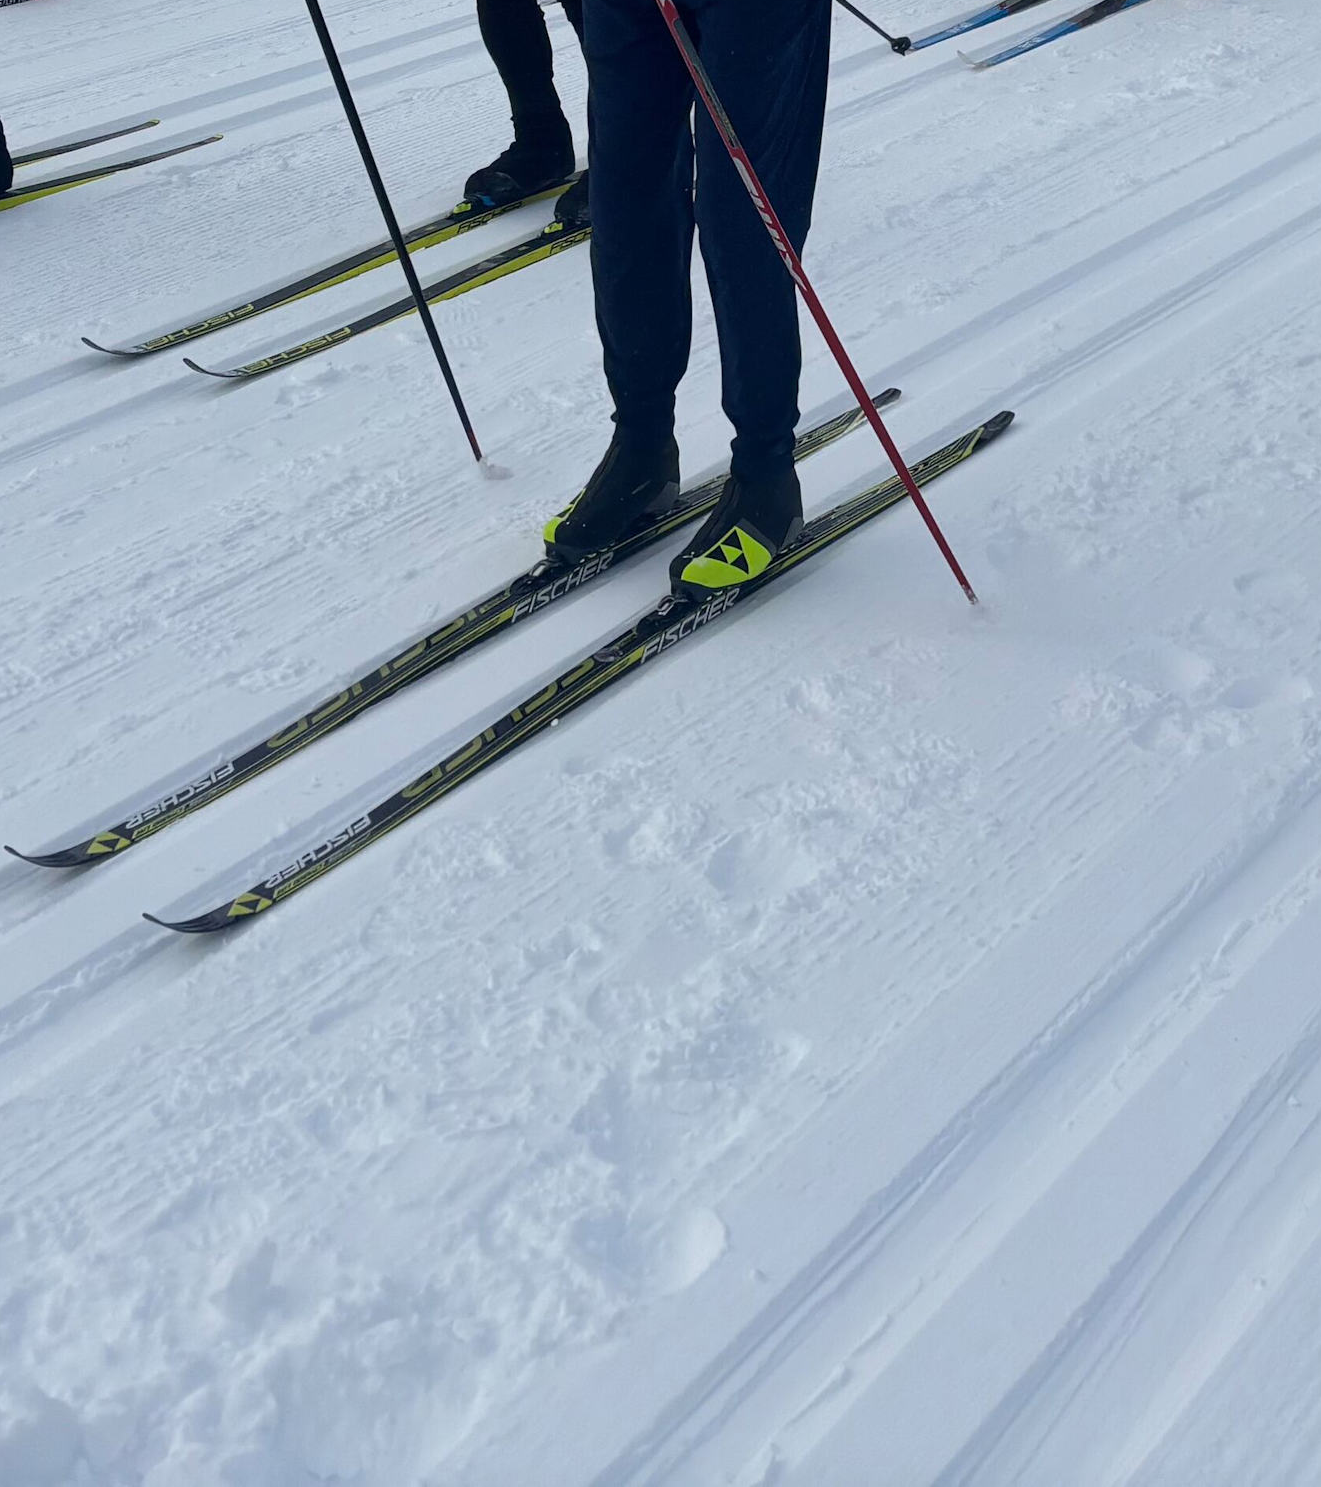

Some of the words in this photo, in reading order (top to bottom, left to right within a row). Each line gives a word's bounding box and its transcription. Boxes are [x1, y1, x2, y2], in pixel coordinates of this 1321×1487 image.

[511, 550, 615, 624] FISCHER
[640, 587, 740, 665] FISCHER
[124, 762, 234, 830] FISCHER
[264, 814, 373, 890] FISCHER
